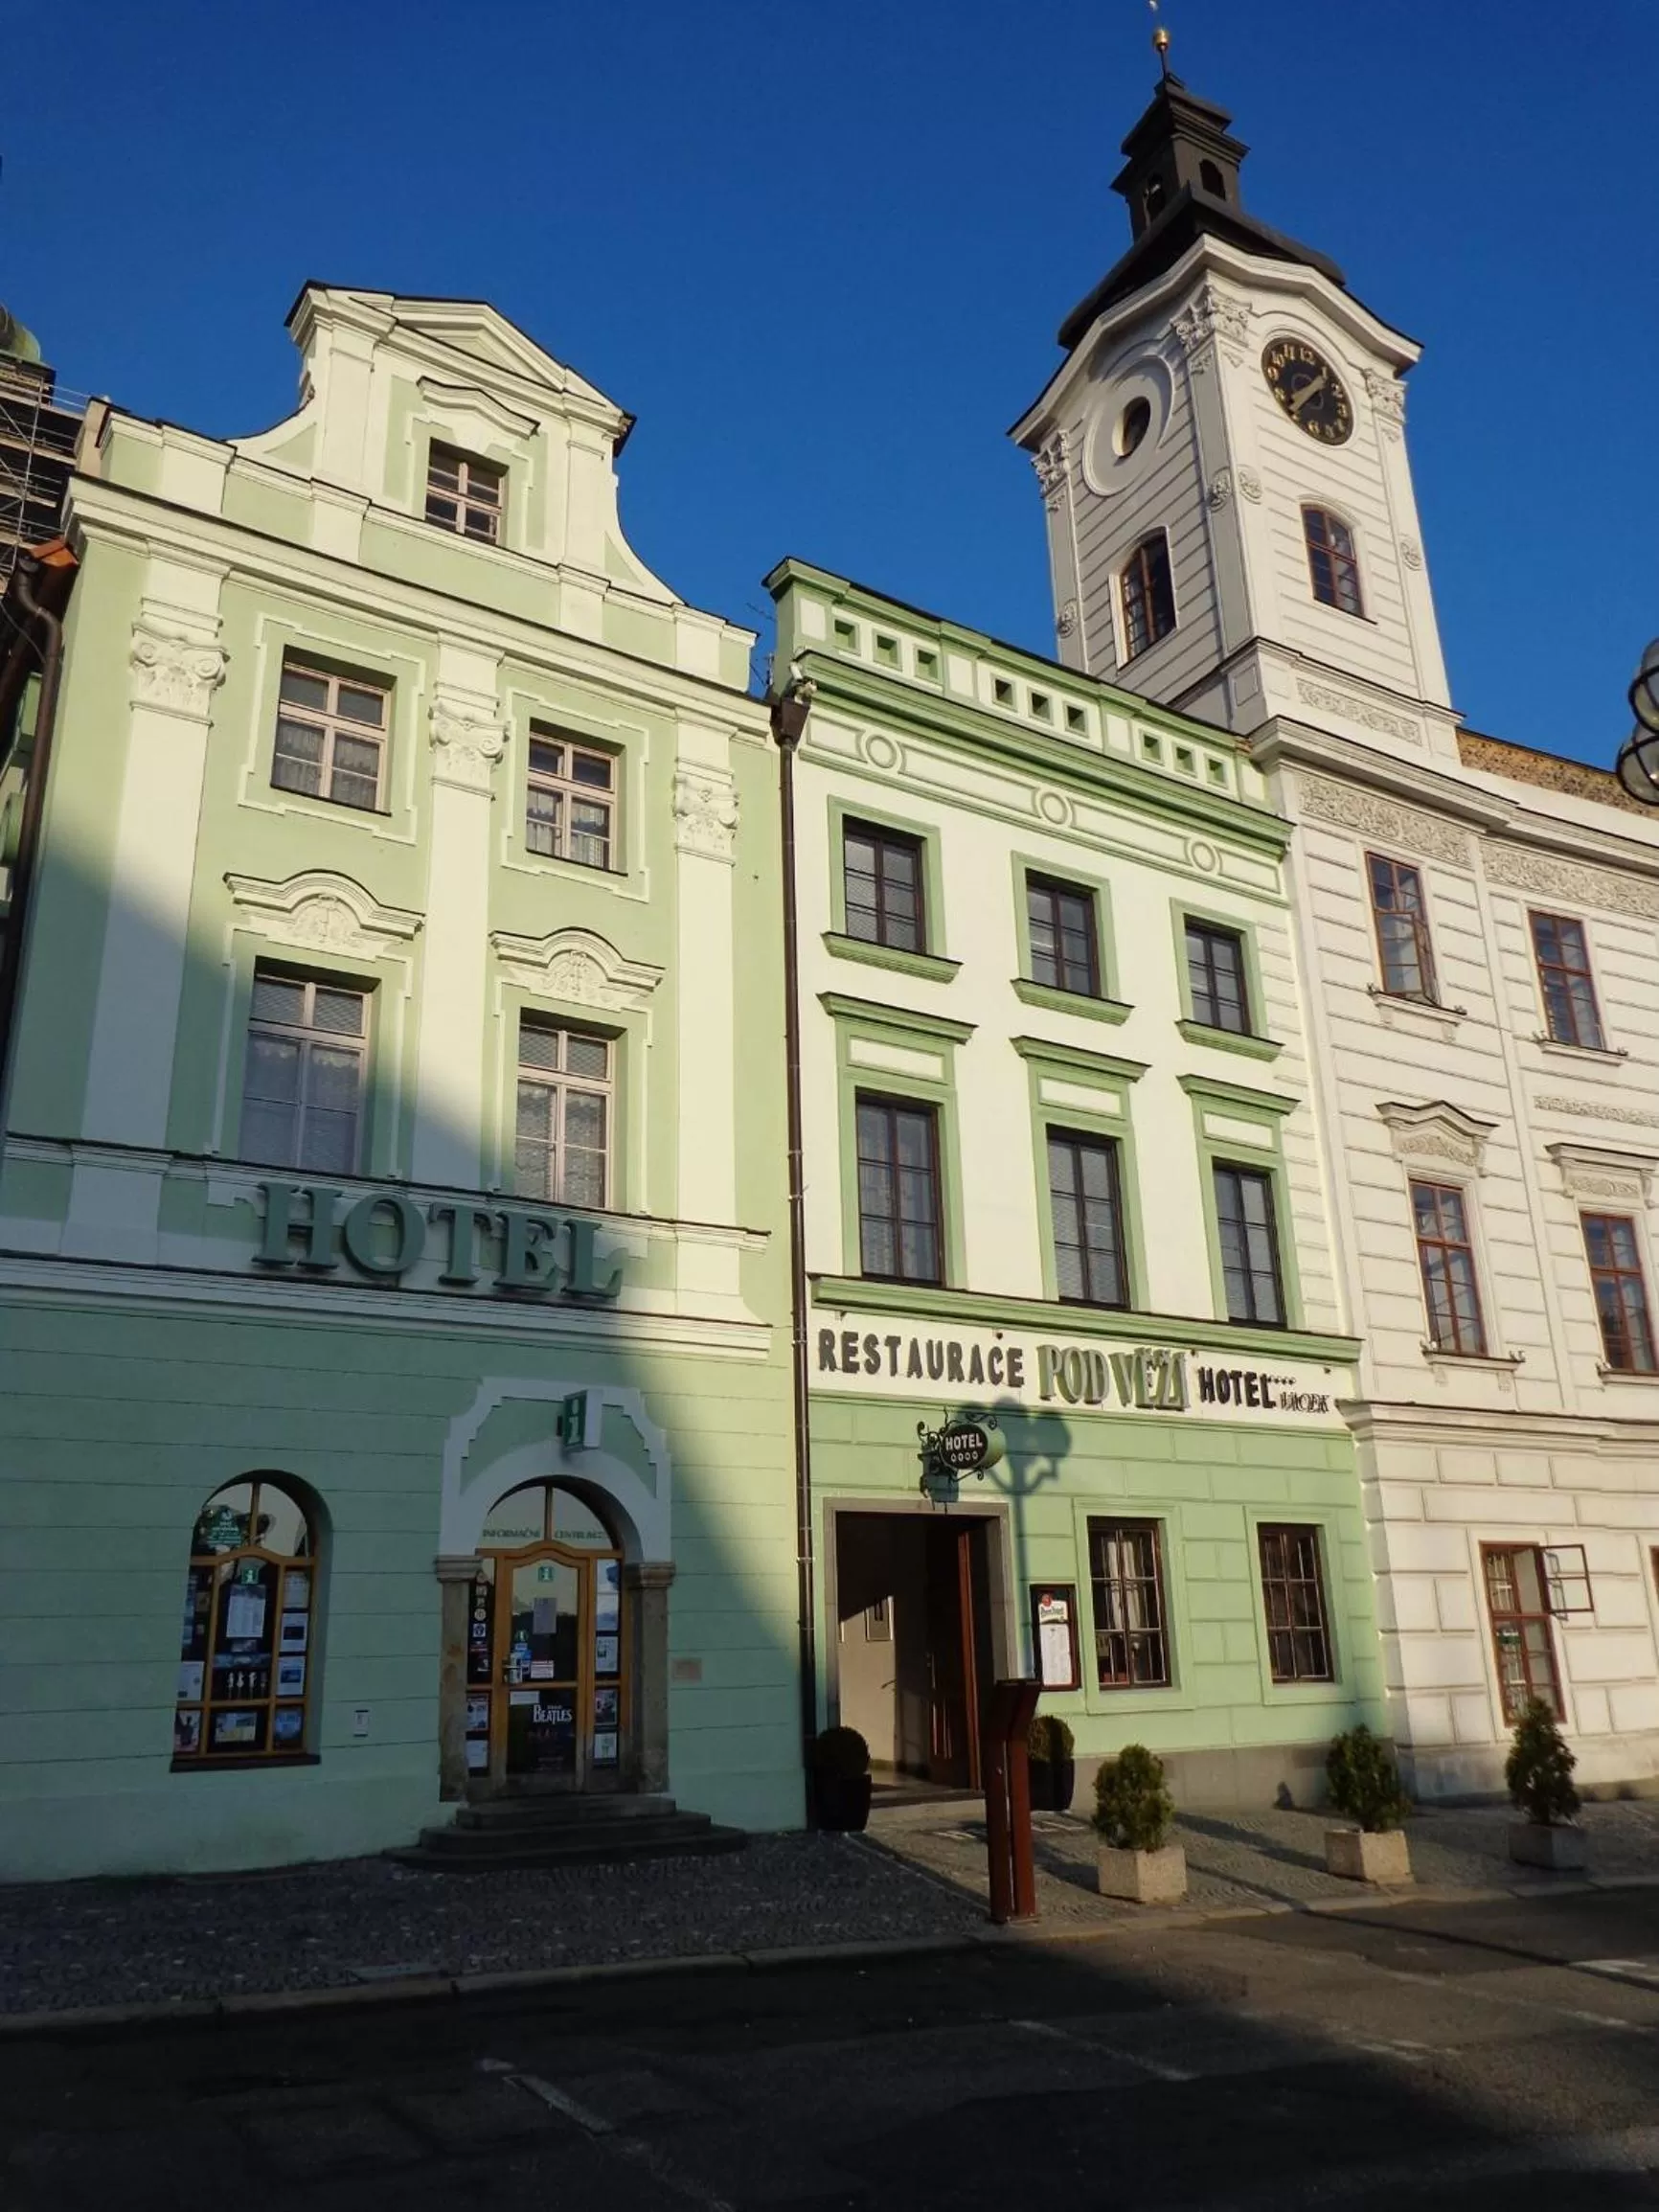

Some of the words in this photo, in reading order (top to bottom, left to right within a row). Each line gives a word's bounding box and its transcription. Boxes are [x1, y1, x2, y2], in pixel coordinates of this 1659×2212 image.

[1300, 347, 1316, 365] 12
[251, 1182, 625, 1298] HOTEL
[818, 1329, 1025, 1387] RESTAURACE
[1036, 1344, 1110, 1404] POD
[1198, 1366, 1277, 1408] HOTEL
[945, 1433, 983, 1451] HOTEL
